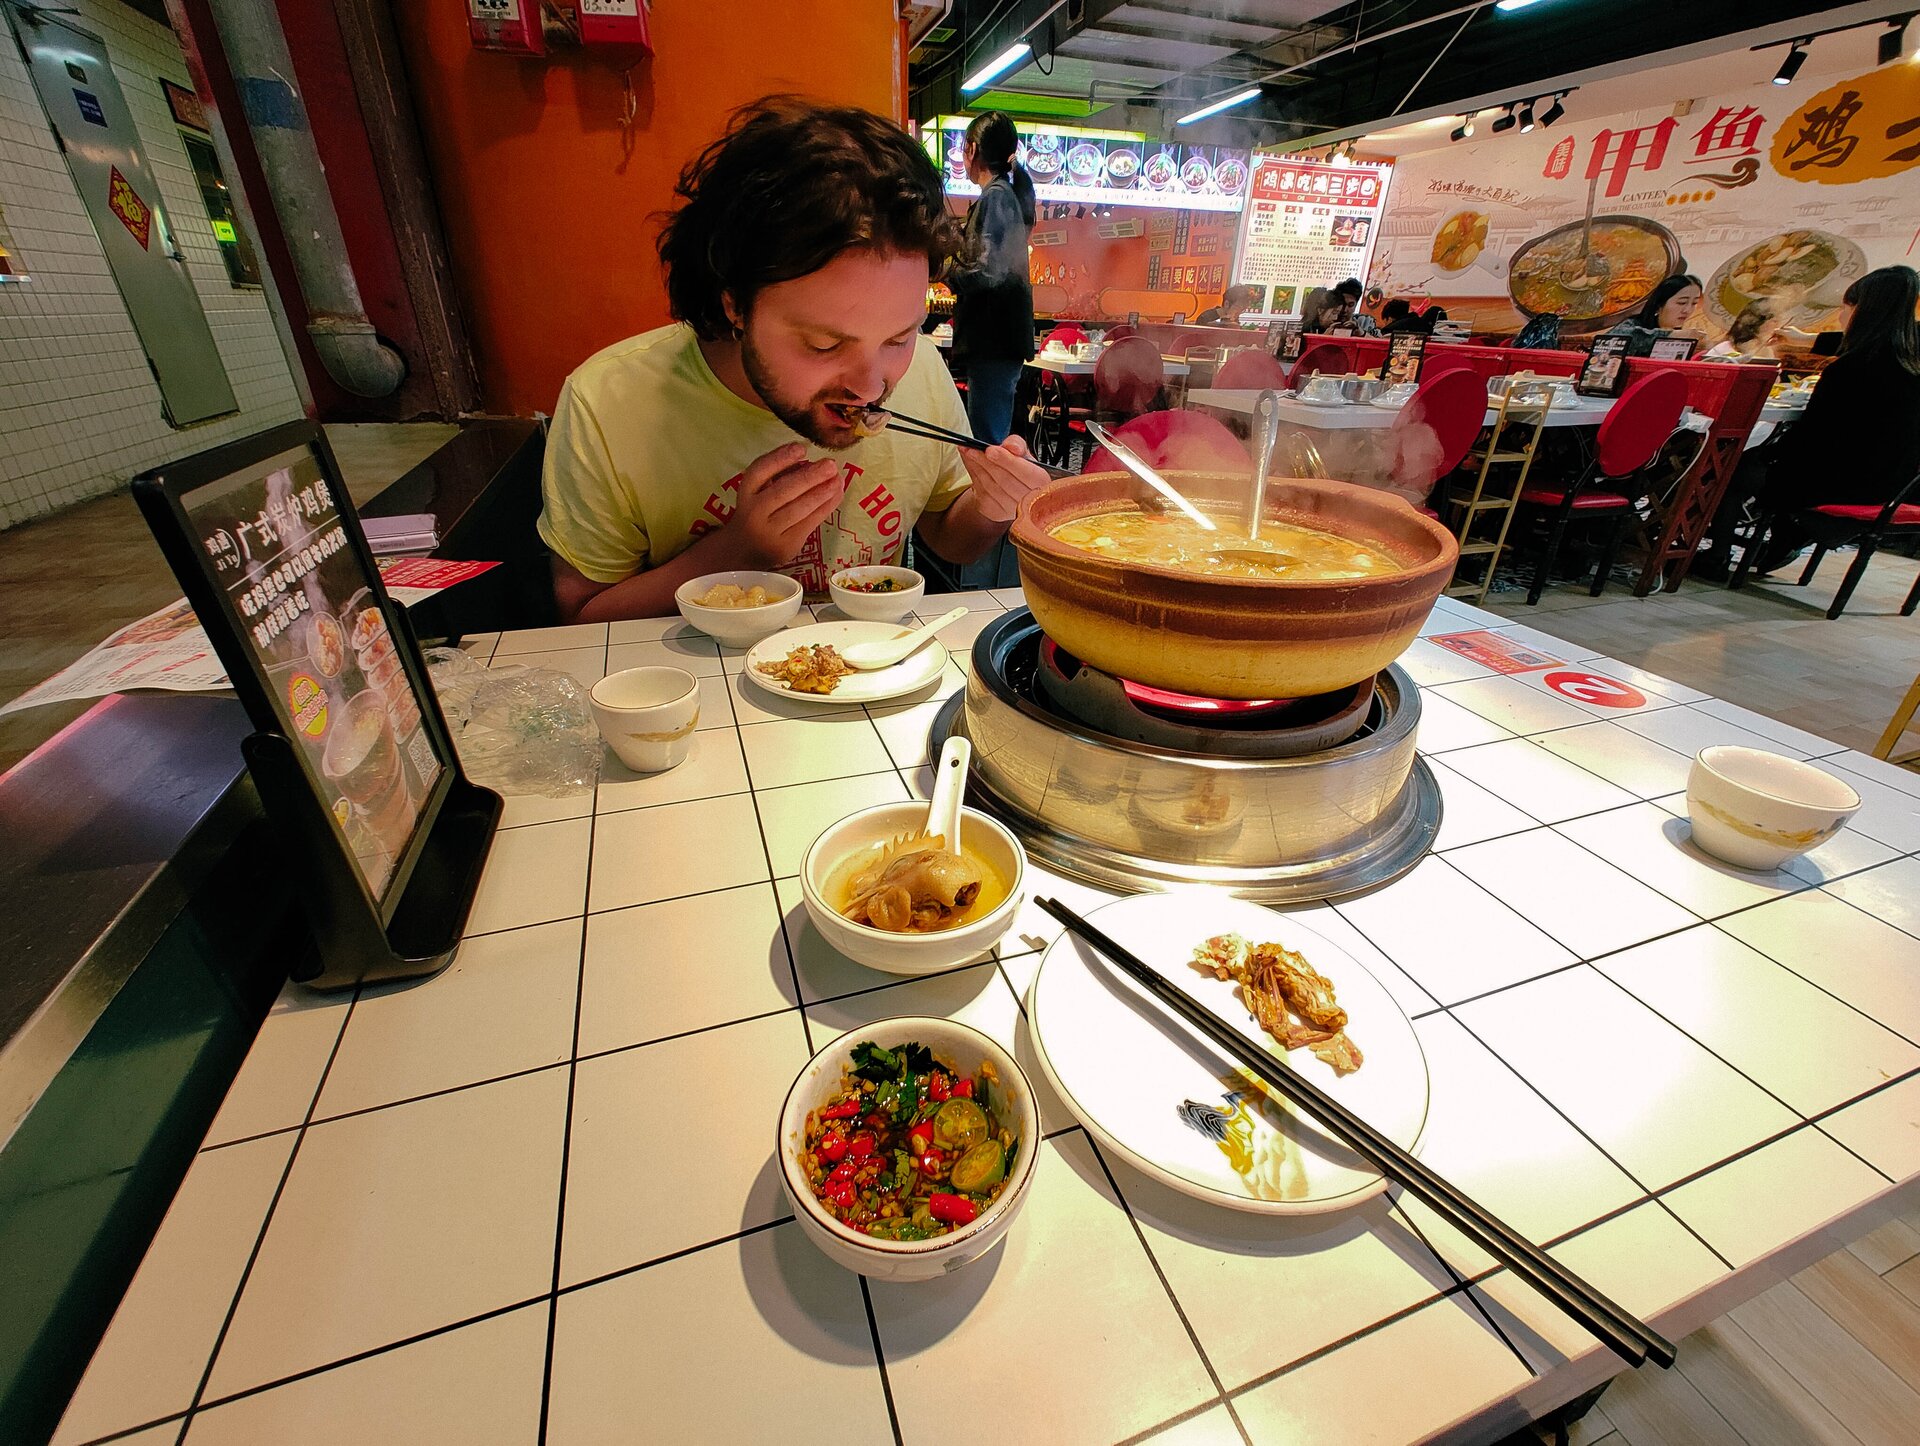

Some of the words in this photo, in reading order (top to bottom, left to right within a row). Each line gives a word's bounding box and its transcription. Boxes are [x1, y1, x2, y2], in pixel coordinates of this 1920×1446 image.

[1551, 142, 1572, 173] 美味
[1584, 104, 1767, 198] 甲鱼
[1622, 189, 1668, 202] CANTEEN
[1631, 200, 1665, 211] CULTURAL
[236, 479, 334, 560] 广式炭炉鸡煲
